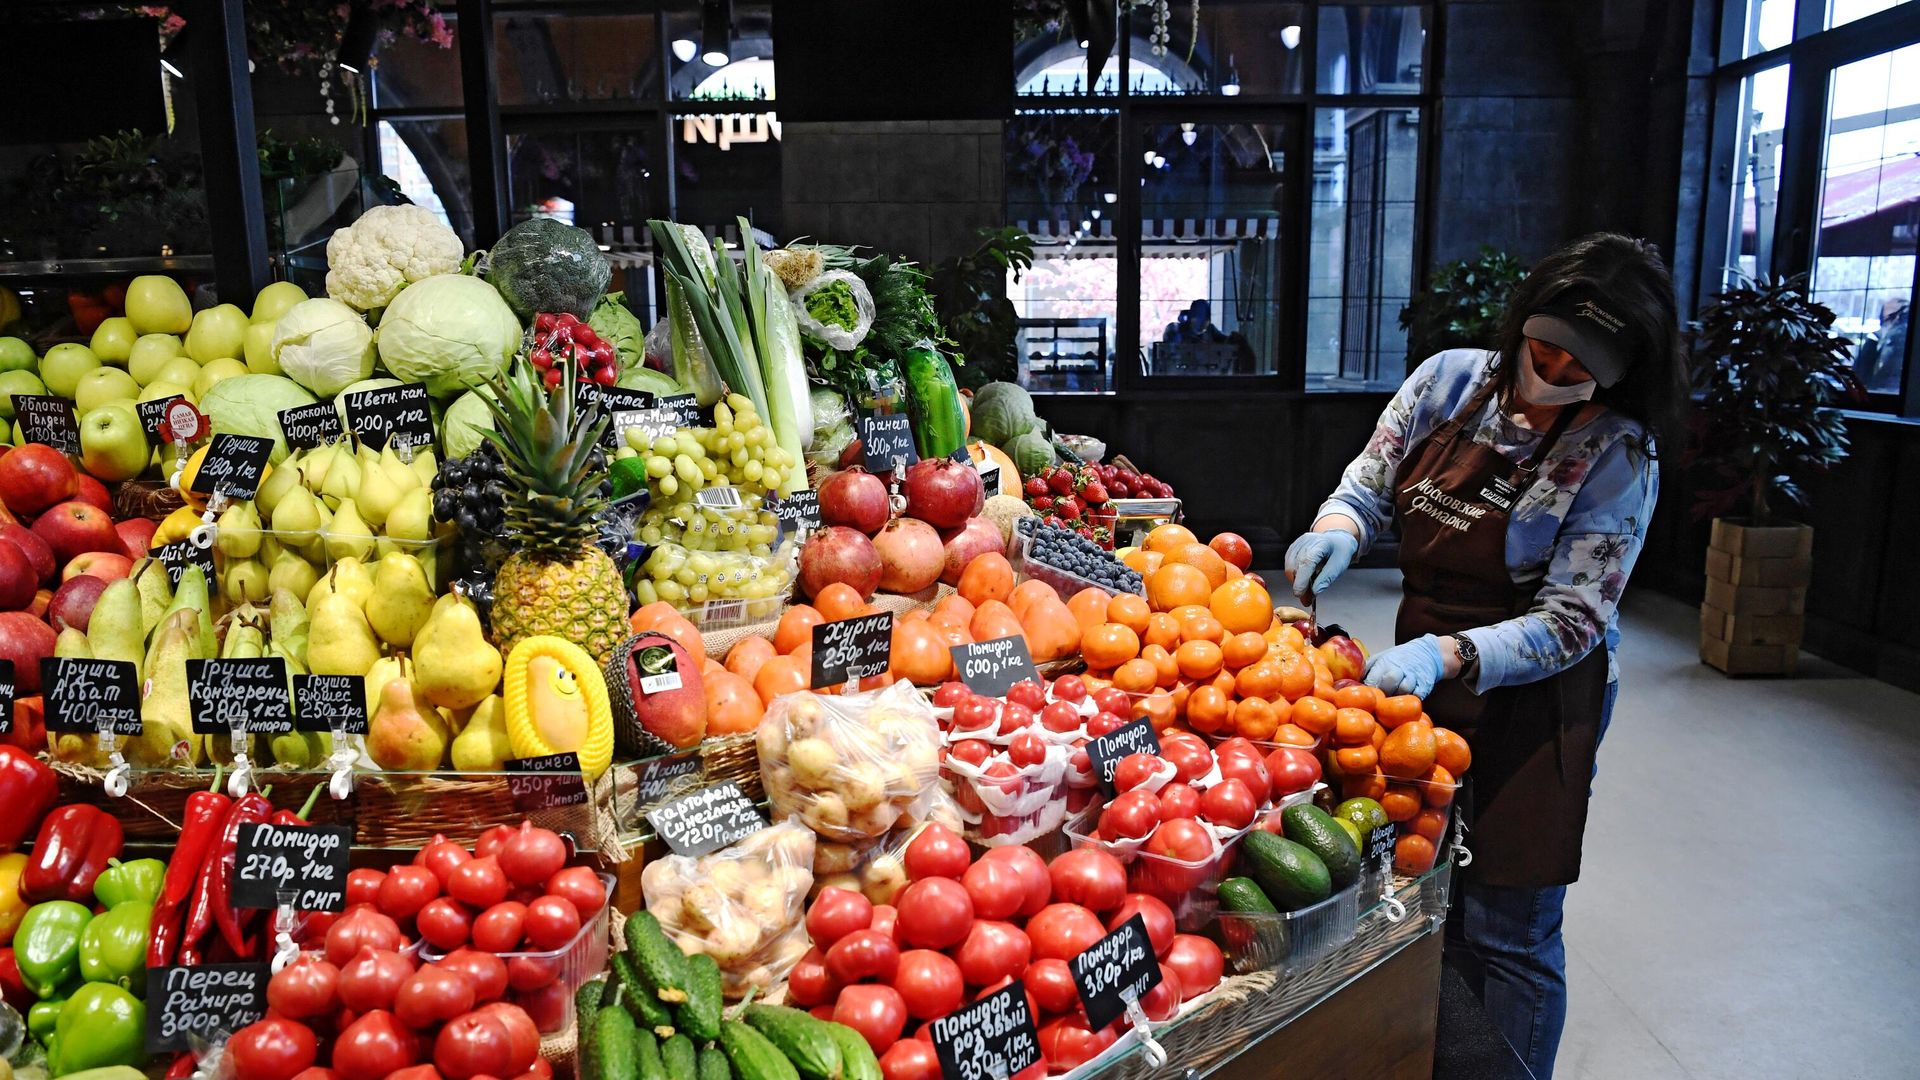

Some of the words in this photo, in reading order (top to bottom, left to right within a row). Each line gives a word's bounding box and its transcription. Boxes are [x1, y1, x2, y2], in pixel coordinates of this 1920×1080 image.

[19, 396, 64, 413] Яблоки
[351, 391, 398, 410] Цветн.
[401, 388, 427, 400] кап.
[578, 383, 645, 410] Капуста
[30, 413, 65, 432] Голден
[283, 405, 335, 429] Брокколи
[865, 417, 909, 440] Гранат
[26, 427, 57, 441] 180р
[218, 435, 259, 455] Груша
[867, 437, 891, 458] 300р
[201, 457, 233, 481] 280р
[1403, 477, 1487, 519] Московские
[1405, 495, 1471, 532] Ярмарки
[823, 616, 891, 648] Хурма
[823, 645, 863, 668] 250р
[968, 640, 1013, 658] Помидор
[58, 657, 121, 687] Груша
[201, 658, 274, 687] Груша
[861, 661, 887, 677] СНГ
[51, 678, 121, 701] Аббат
[190, 680, 289, 708] Конференц
[298, 688, 351, 702] Дюшес
[307, 675, 351, 692] Груша
[1098, 725, 1148, 758] Помидор
[522, 756, 572, 770] Манго
[645, 761, 695, 780] Манго
[651, 784, 741, 825] Картофель
[252, 824, 340, 860] Помидор
[241, 854, 295, 888] 270р
[302, 890, 341, 909] СНГ
[1078, 926, 1132, 974] Помидор
[167, 967, 255, 996] Перец
[1085, 962, 1121, 998] 380р
[164, 991, 254, 1013] Рамиро
[161, 1012, 220, 1036] 300р
[935, 991, 1011, 1044] Помидор
[953, 1000, 1026, 1064] розовый
[1010, 1046, 1035, 1072] СНГ
